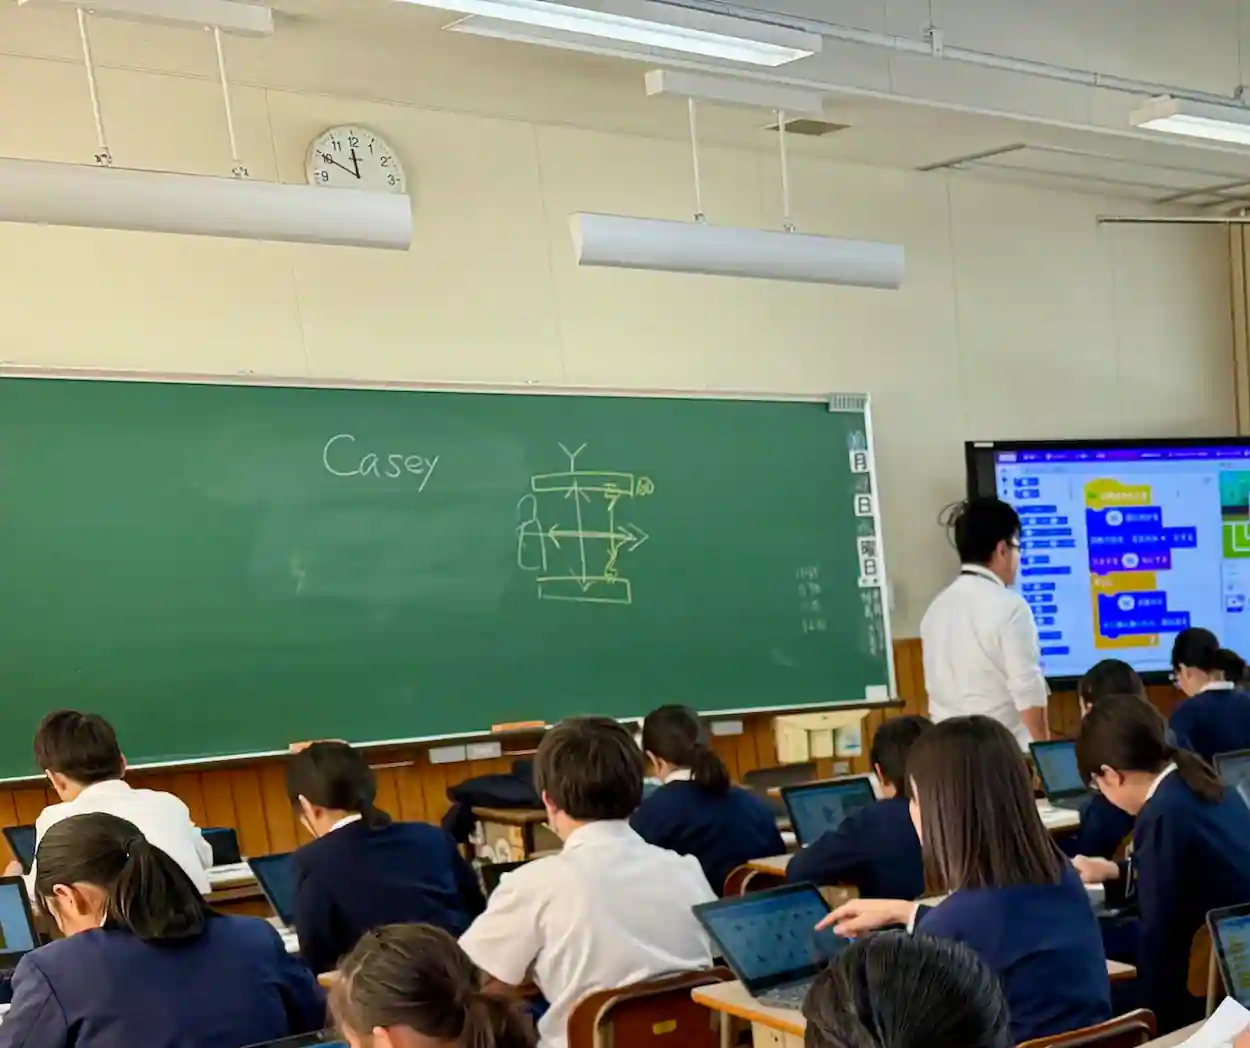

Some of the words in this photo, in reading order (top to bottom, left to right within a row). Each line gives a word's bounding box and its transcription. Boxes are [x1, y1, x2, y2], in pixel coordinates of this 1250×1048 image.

[331, 140, 342, 152] 11
[348, 136, 360, 148] 12
[368, 143, 374, 156] 1
[321, 153, 333, 164] 10
[380, 156, 389, 167] 2
[321, 170, 329, 182] 9
[387, 174, 396, 186] 3
[322, 433, 440, 492] Casey
[854, 452, 867, 471] 月
[858, 497, 871, 514] 日
